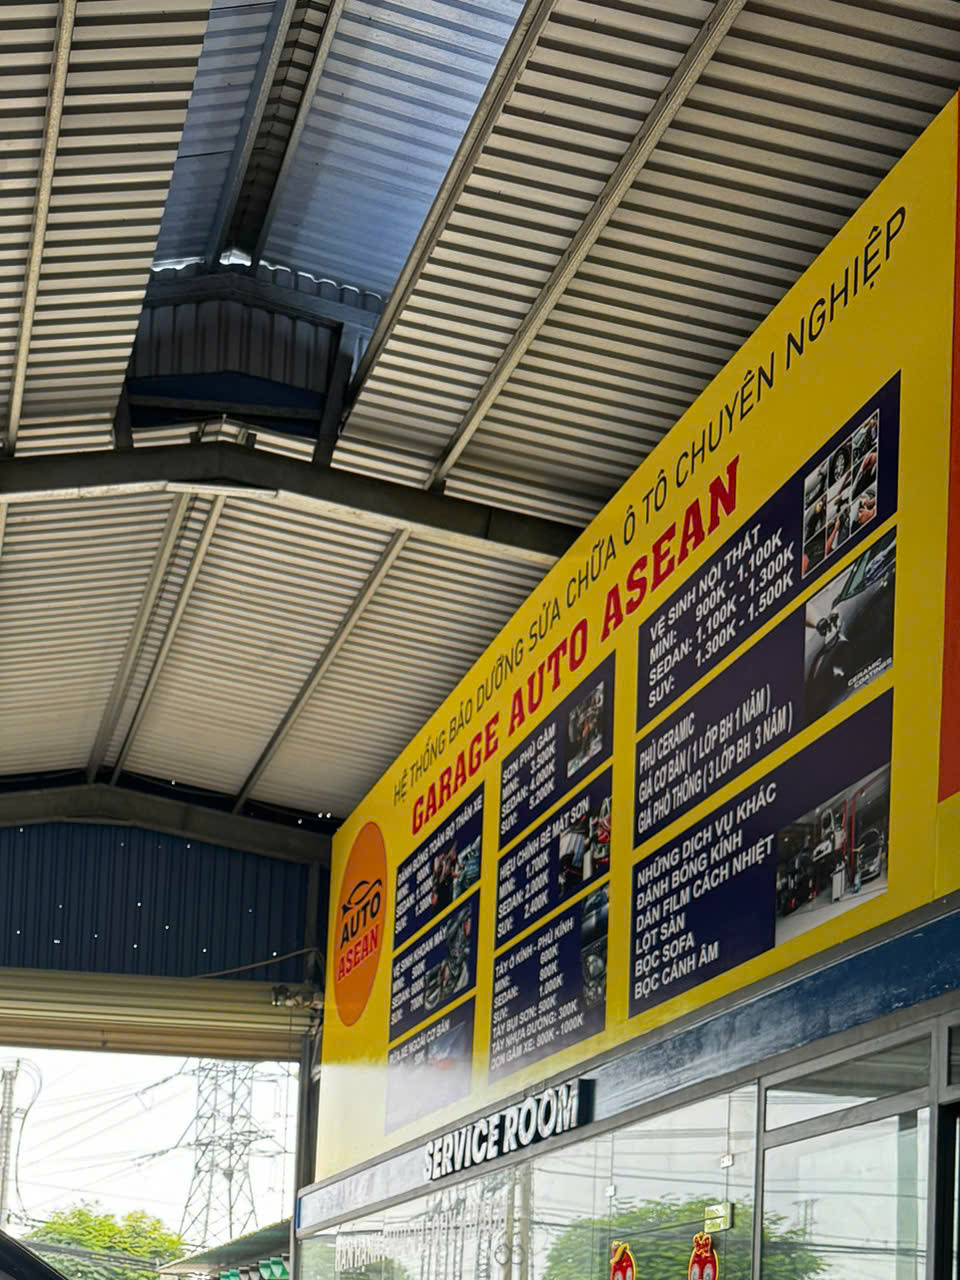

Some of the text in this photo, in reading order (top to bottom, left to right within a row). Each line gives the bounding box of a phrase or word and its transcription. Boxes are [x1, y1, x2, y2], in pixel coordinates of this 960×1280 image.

[477, 638, 524, 712] DƯỠNG
[566, 534, 617, 608] CHỮA
[623, 504, 636, 546] Ô
[642, 469, 668, 524] TÔ
[675, 352, 775, 489] CHUYÊN
[785, 206, 906, 371] NGHIỆP
[411, 453, 740, 836] GARAGE AUTO ASEAN
[648, 637, 693, 687] SEDAN:
[695, 593, 737, 644] 1.100K
[747, 540, 795, 597] 1.300K
[648, 675, 676, 709] SUV:
[695, 618, 737, 668] 1.300K
[747, 567, 794, 622] 1.500K
[649, 629, 678, 665] MINI:
[696, 581, 727, 622] 900K
[737, 527, 784, 583] 1.100K
[649, 614, 667, 641] VỆ
[668, 587, 697, 626] SINH
[699, 557, 722, 598] NỘI
[637, 800, 653, 834] GIÁ
[671, 769, 702, 810] THÔNG
[708, 760, 715, 784] 3
[736, 732, 751, 764] BH
[755, 725, 762, 750] 3
[638, 769, 653, 804] GIÁ
[653, 763, 668, 793] CƠ
[719, 713, 734, 744] BH
[735, 707, 740, 731] 1
[657, 711, 696, 761] CERAMIC
[635, 828, 742, 911] ĐÁNH BÓNG KÍNH
[635, 833, 775, 933] DÁN FILM CÁCH NHIỆT
[637, 782, 777, 889] NHỮNG DỊCH VỤ KHÁC
[337, 924, 380, 982] ASEAN
[340, 891, 381, 949] AUTO
[634, 931, 695, 977] BỌC SOFA
[660, 912, 686, 941] SÀN
[634, 973, 660, 1000] BỌC
[698, 940, 720, 968] ÂM
[424, 1080, 579, 1181] SERVICE ROOM
